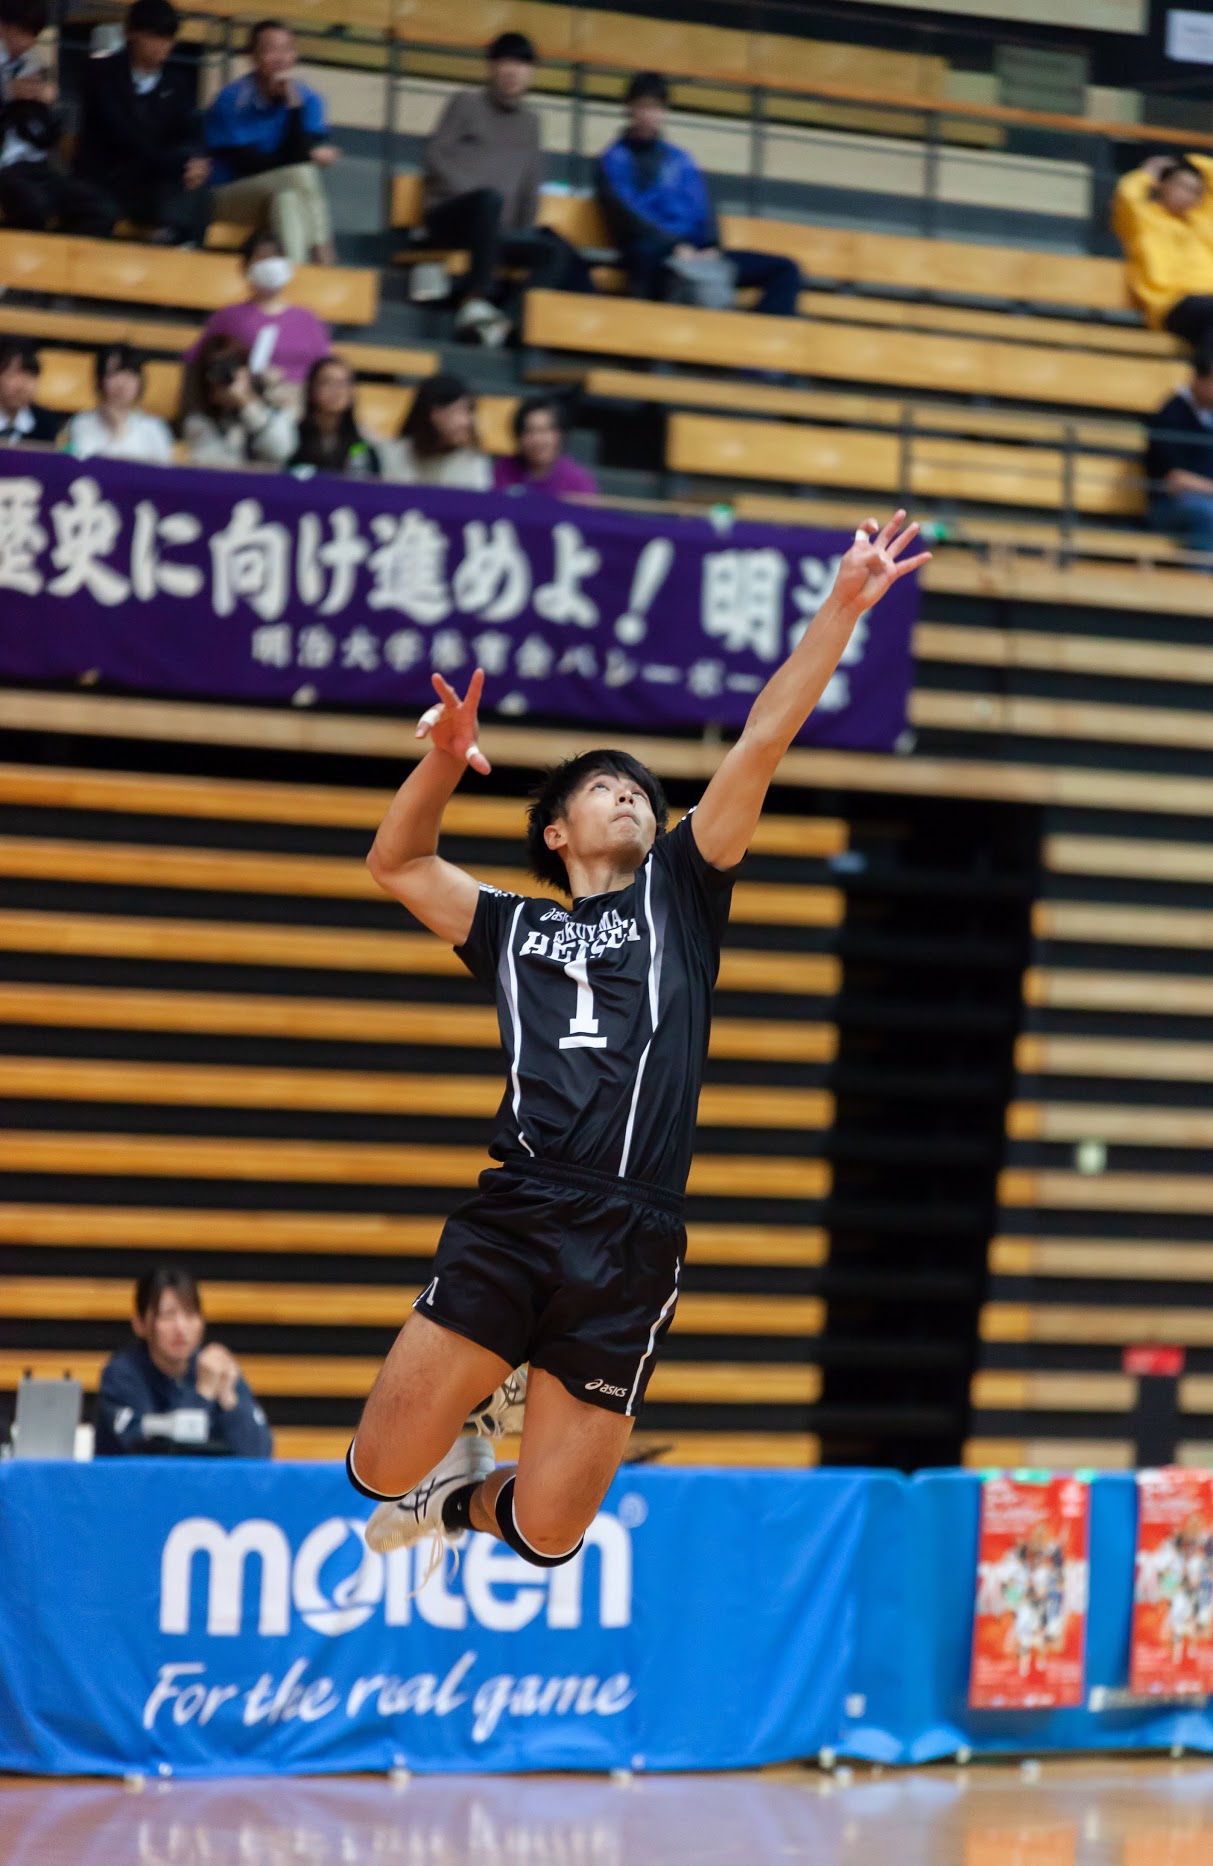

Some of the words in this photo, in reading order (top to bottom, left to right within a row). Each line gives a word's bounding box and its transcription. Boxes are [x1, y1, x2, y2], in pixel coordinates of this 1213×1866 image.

[519, 917, 641, 963] HEISEI
[559, 956, 608, 1050] 1
[143, 1661, 240, 1730] For
[242, 1656, 341, 1727] the
[345, 1649, 469, 1718] real
[470, 1671, 638, 1744] game
